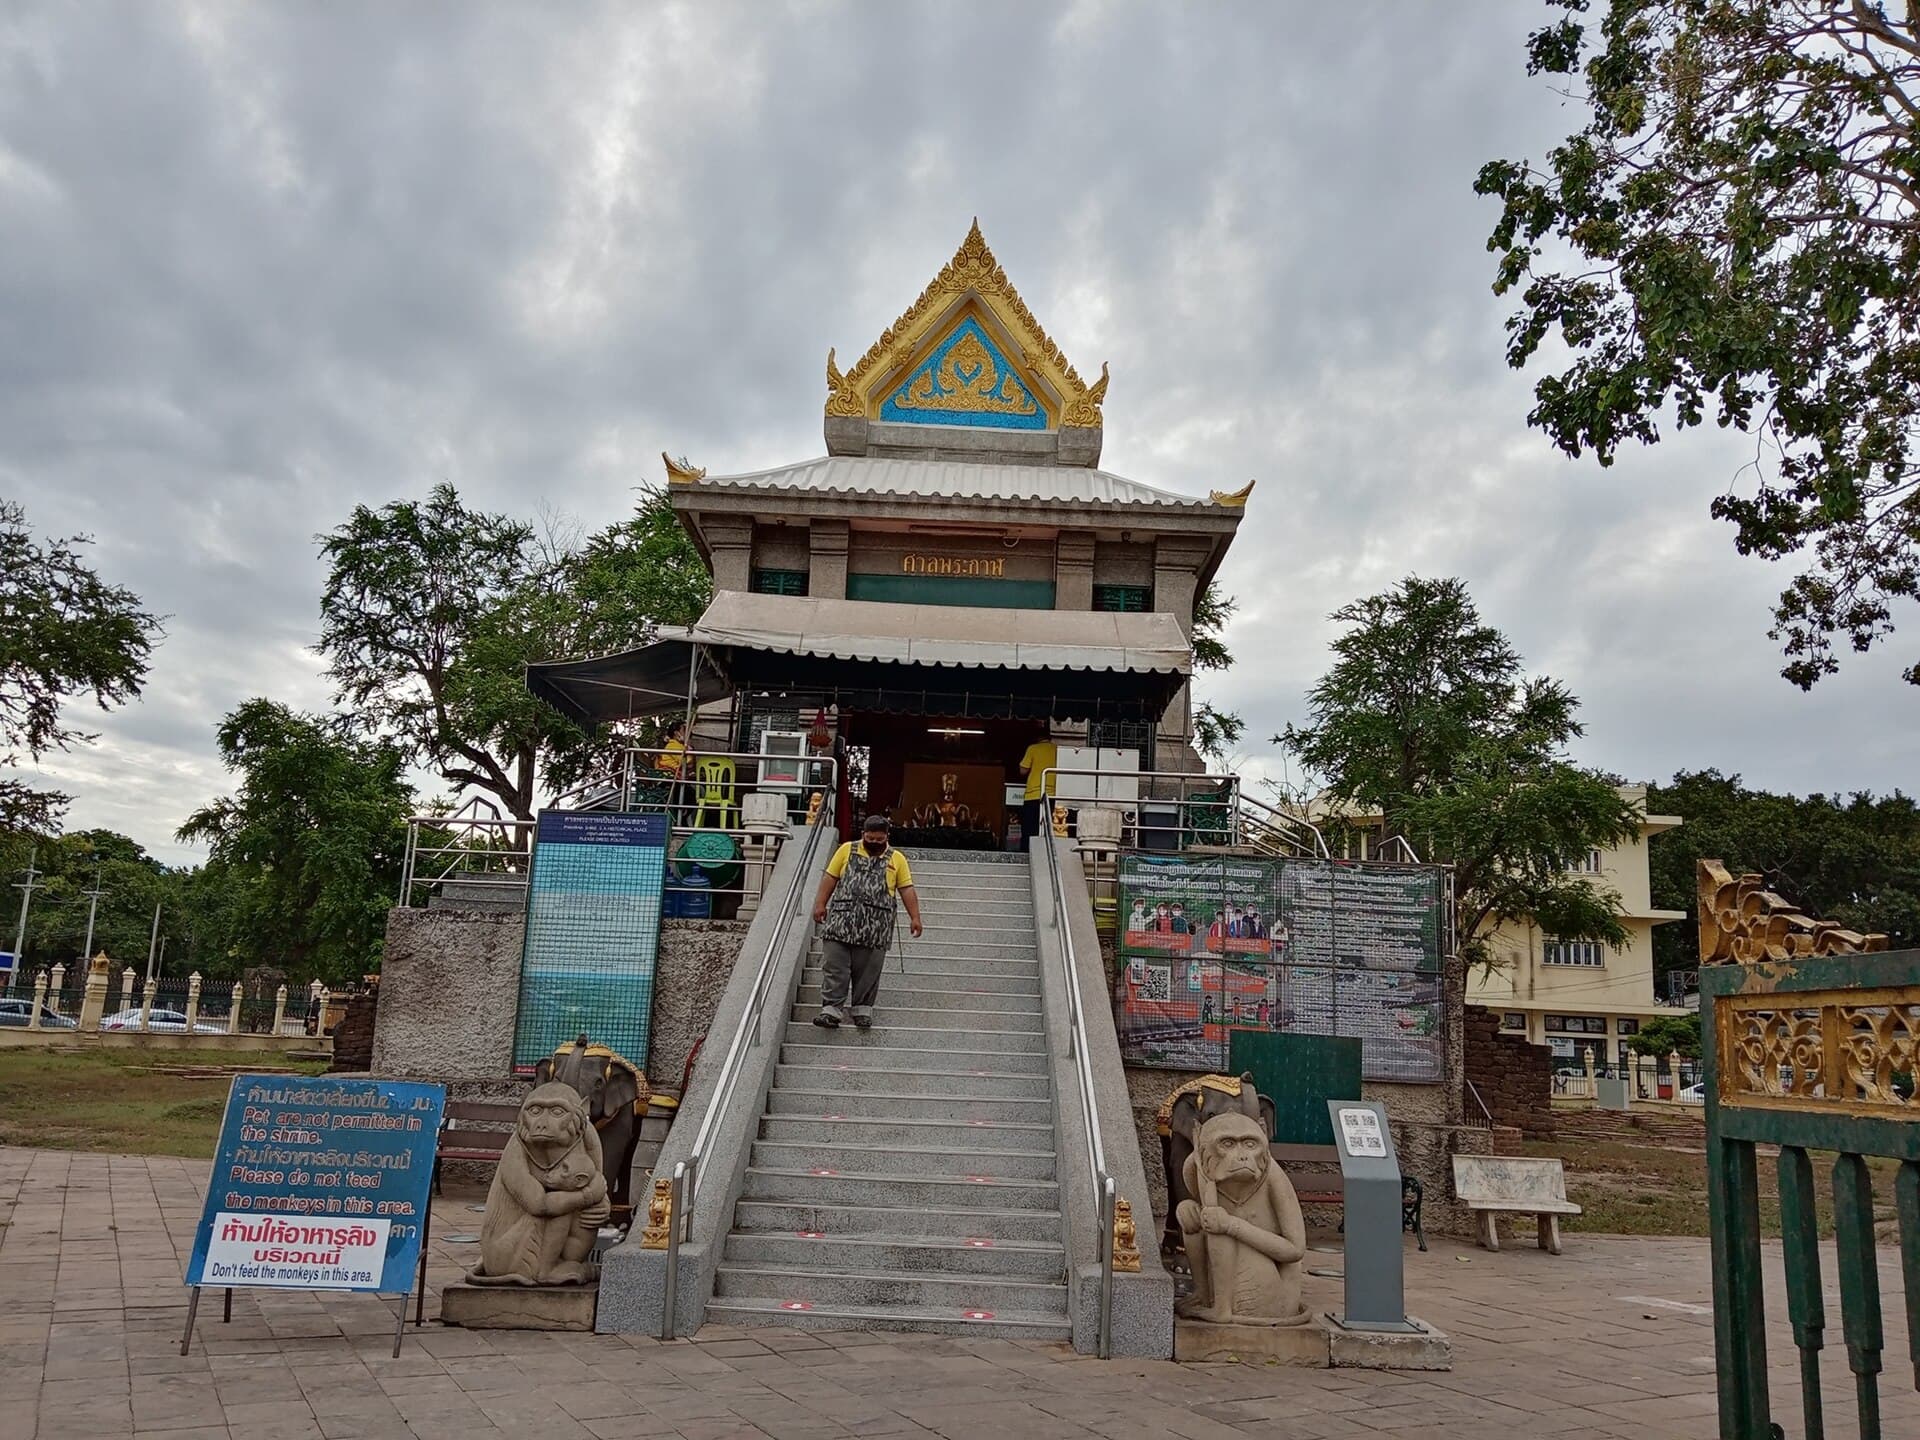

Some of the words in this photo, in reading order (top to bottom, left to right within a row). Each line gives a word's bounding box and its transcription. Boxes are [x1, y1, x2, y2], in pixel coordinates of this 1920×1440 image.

[903, 553, 1006, 576] ศาลพระกาฬ
[243, 1106, 269, 1125] Pet
[276, 1111, 301, 1127] are
[303, 1109, 329, 1127] not
[330, 1111, 404, 1131] permitted
[407, 1115, 422, 1131] in
[240, 1126, 265, 1143] the
[230, 1166, 284, 1185] Please
[288, 1168, 310, 1186] do
[314, 1170, 341, 1187] not
[346, 1171, 382, 1189] feed
[225, 1192, 251, 1209] the
[253, 1193, 325, 1216] monkeys
[326, 1195, 342, 1212] in
[344, 1196, 373, 1213] this
[377, 1200, 415, 1215] area.
[221, 1217, 377, 1248] ห้ามให้อาหารลิง
[253, 1246, 342, 1265] บริเวณนี้
[211, 1262, 237, 1277] Don't
[238, 1264, 260, 1279] feed
[261, 1264, 276, 1279] the
[277, 1265, 319, 1283] monkeys
[320, 1266, 331, 1280] in
[332, 1267, 349, 1281] this
[350, 1270, 374, 1282] area.
